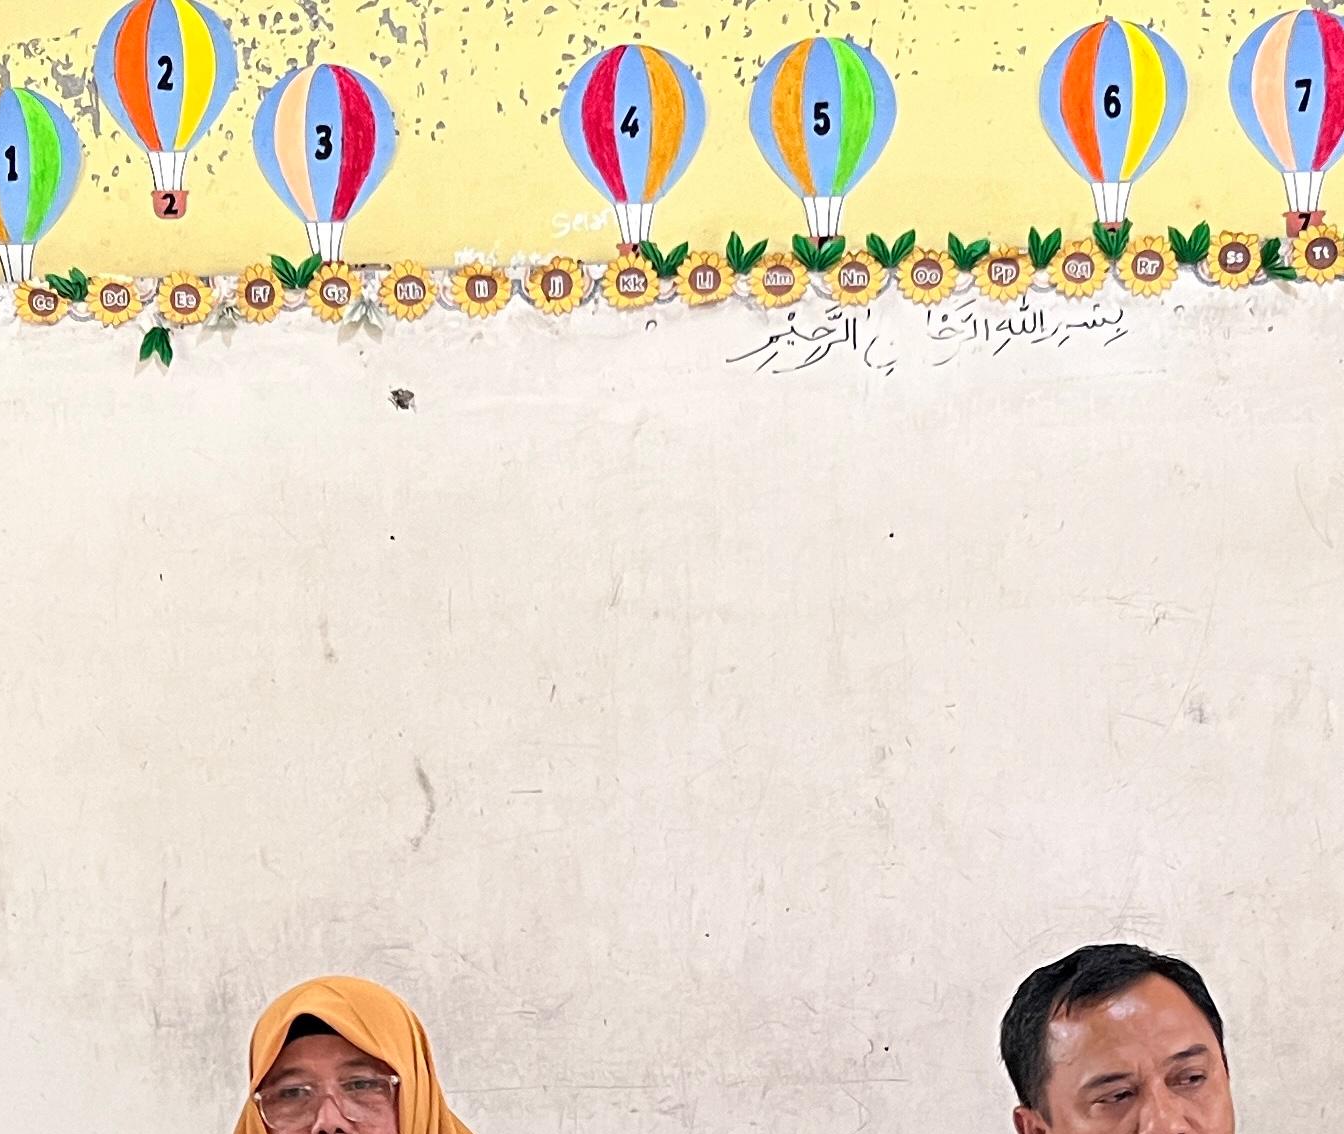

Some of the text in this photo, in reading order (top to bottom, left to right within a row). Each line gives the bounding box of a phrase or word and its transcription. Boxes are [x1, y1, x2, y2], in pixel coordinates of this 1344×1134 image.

[157, 55, 174, 91] 2
[1103, 84, 1121, 118] 6
[1295, 78, 1312, 112] 7
[620, 106, 639, 138] 4
[813, 101, 831, 136] 5
[314, 124, 333, 160] 3
[4, 145, 18, 181] 1
[162, 193, 179, 215] 2
[1226, 252, 1243, 265] Ss
[1312, 245, 1329, 260] Tt
[914, 269, 940, 284] Oo
[991, 263, 1015, 282] Pp
[1065, 259, 1090, 279] Qq
[1137, 259, 1158, 275] Rr
[548, 276, 563, 297] Jj
[620, 275, 645, 293] Kk
[764, 273, 792, 286] Mm
[841, 270, 867, 288] Nn
[102, 290, 128, 307] Dd
[174, 291, 197, 308] Ee
[251, 286, 270, 302] Ff
[323, 284, 348, 304] Gg
[397, 281, 422, 299] Hh
